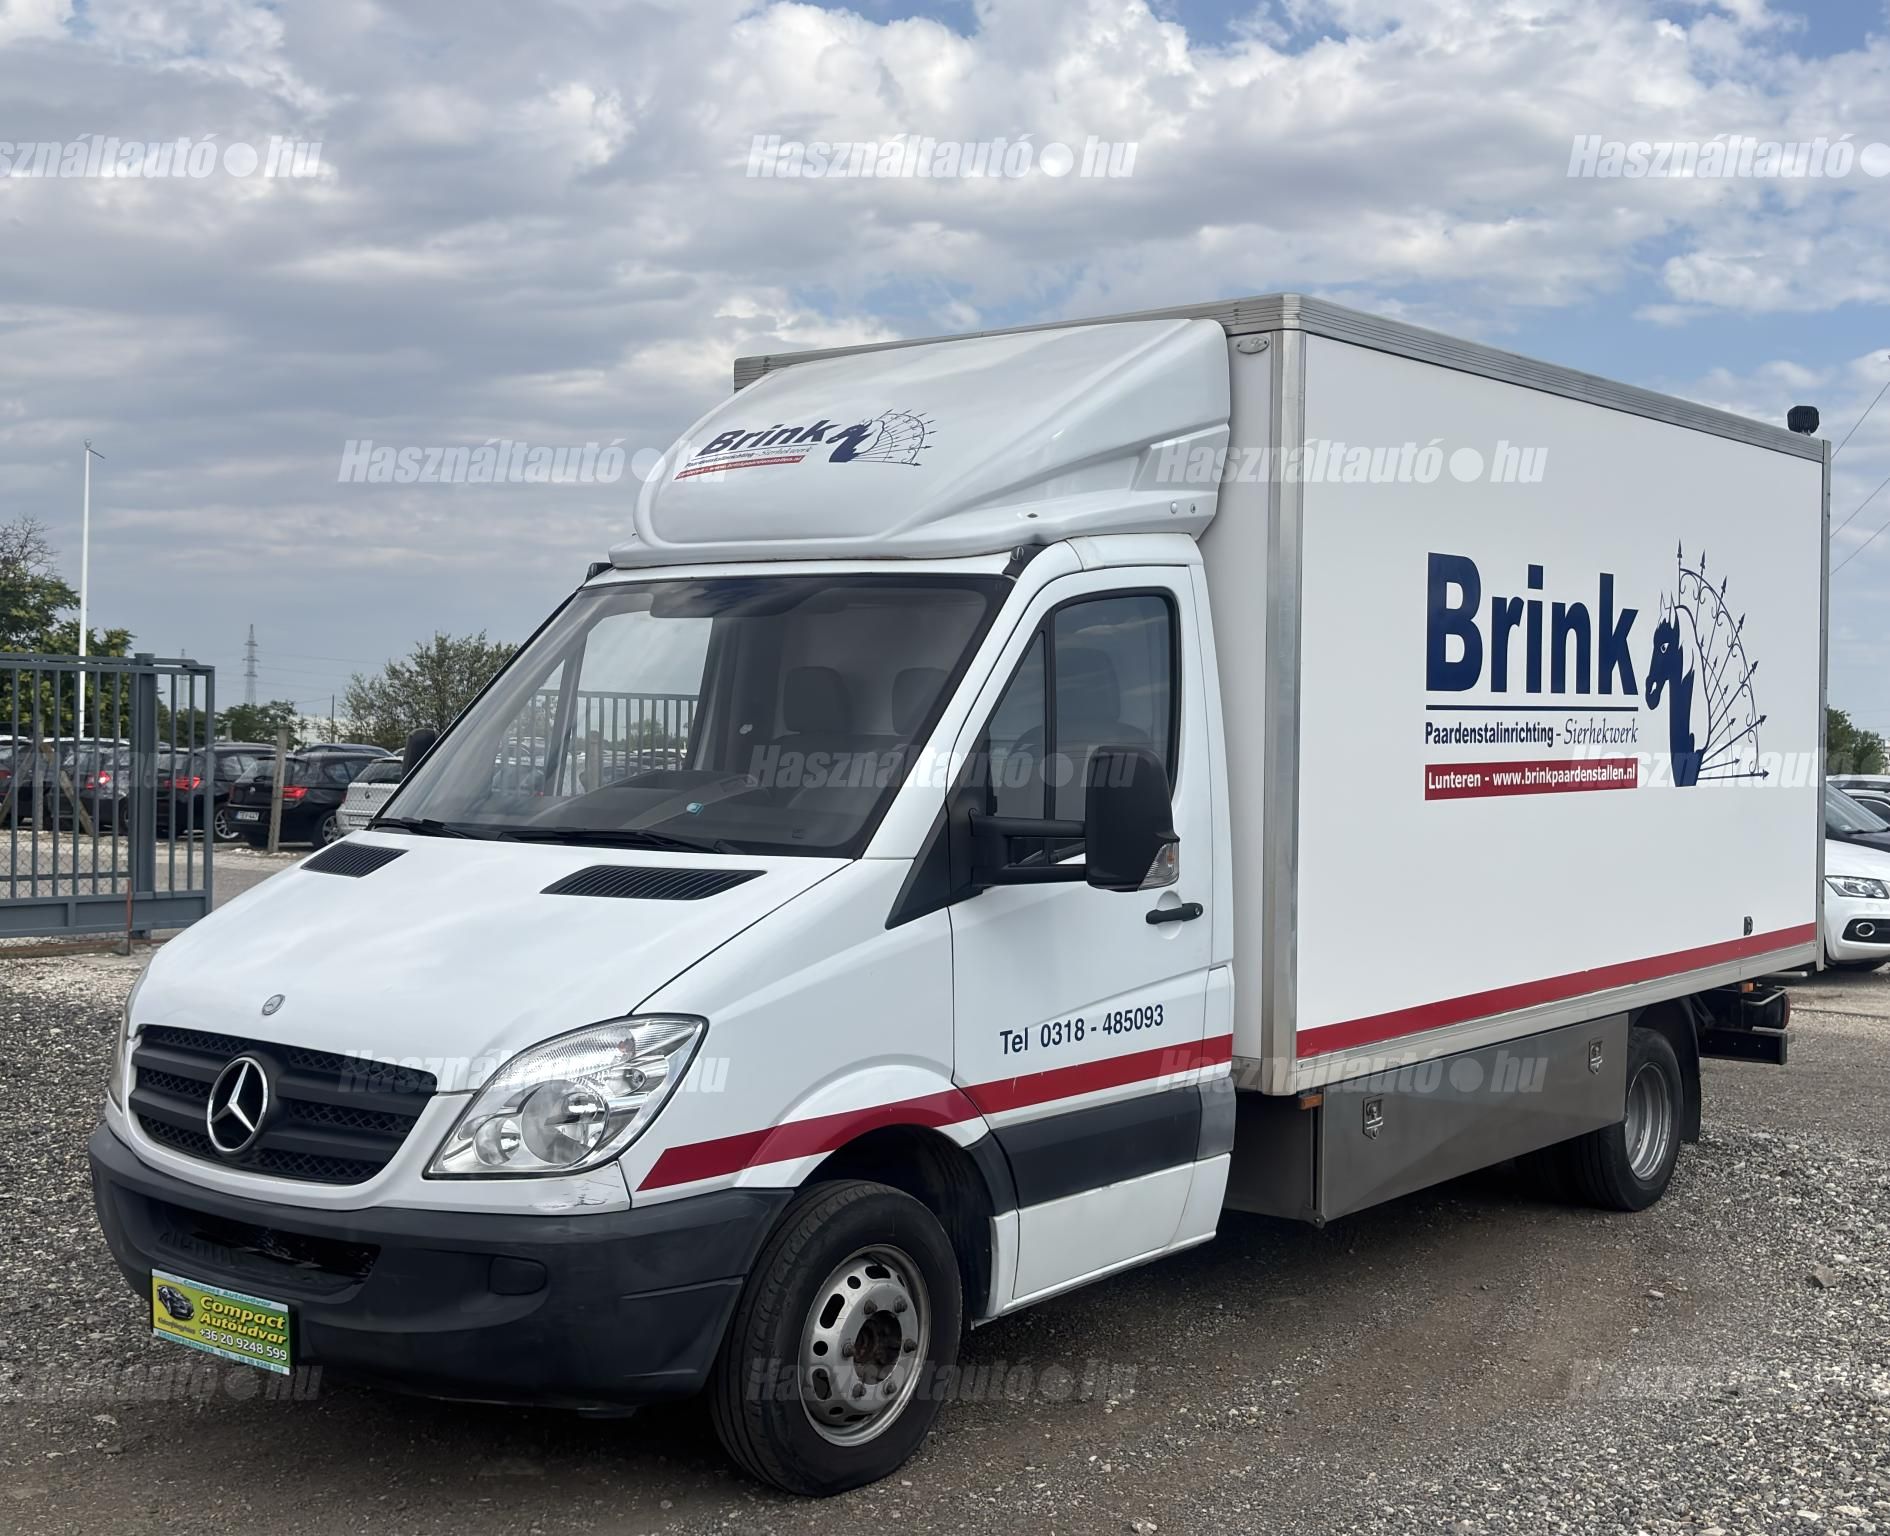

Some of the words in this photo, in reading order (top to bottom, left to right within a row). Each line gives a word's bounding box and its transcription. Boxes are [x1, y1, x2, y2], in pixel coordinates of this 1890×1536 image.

[696, 420, 841, 457] Brink
[1426, 552, 1639, 695] Brink
[1425, 722, 1554, 748] Paardenstalinrichting
[1564, 718, 1639, 745] Sierhekwerk
[1428, 772, 1481, 790] Lunteren
[1493, 763, 1636, 787] www.brinkpaardenstallen.nl
[999, 1027, 1029, 1055] Tel
[1040, 1018, 1085, 1048] 0318
[1102, 1004, 1164, 1036] 485093
[199, 1312, 288, 1344] Autóudvar
[200, 1296, 286, 1330] Compact
[200, 1328, 218, 1341] +36
[221, 1334, 234, 1346] 20
[236, 1337, 264, 1354] 9248
[266, 1346, 287, 1361] 599
